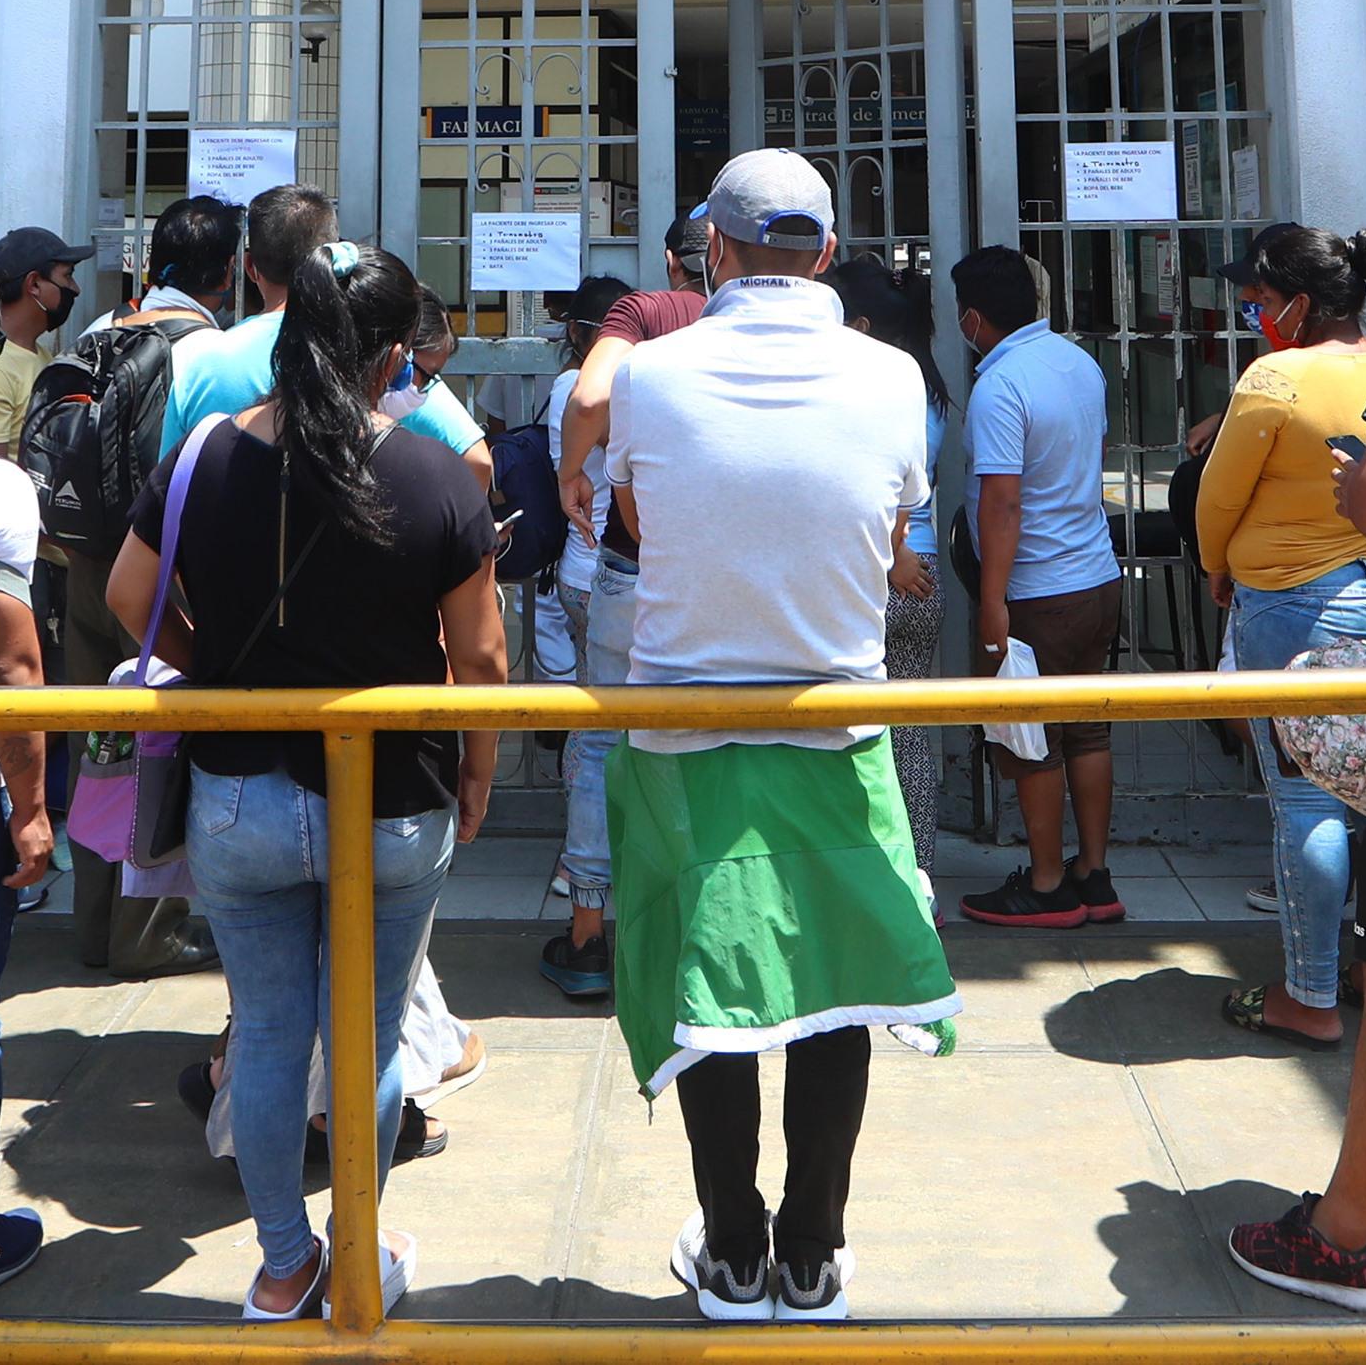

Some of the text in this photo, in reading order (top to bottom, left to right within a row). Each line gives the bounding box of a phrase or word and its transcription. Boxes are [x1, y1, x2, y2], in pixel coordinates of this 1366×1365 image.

[781, 108, 837, 122] Etrad
[853, 107, 873, 121] de
[442, 120, 522, 133] FAMACI
[740, 278, 791, 288] MICHAEL
